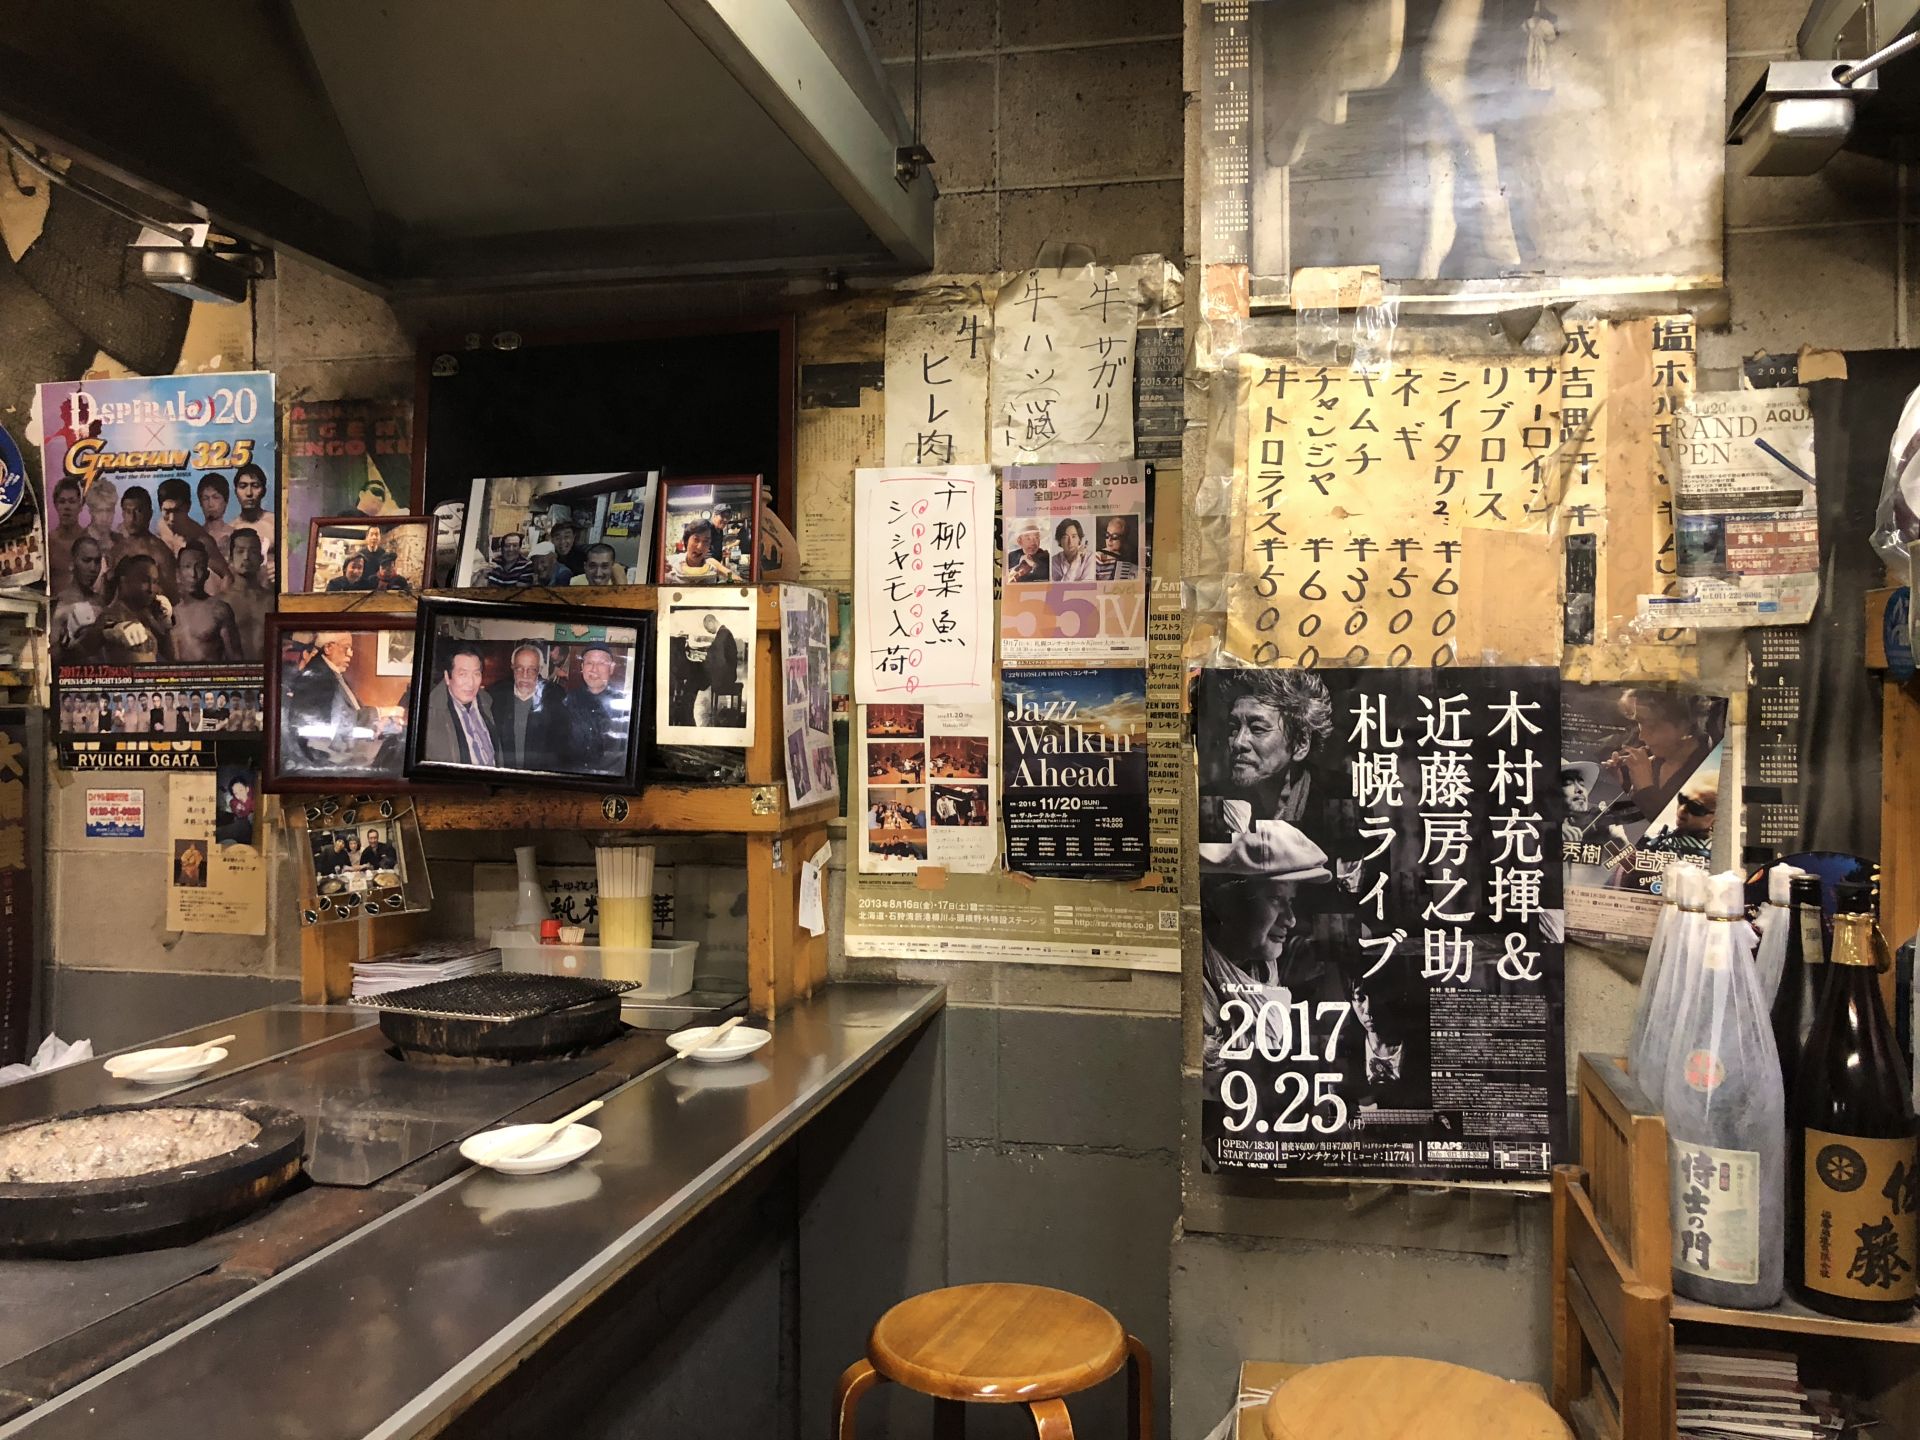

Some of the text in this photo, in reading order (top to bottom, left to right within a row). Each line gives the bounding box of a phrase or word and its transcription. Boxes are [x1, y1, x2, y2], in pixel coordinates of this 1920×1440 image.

[1080, 281, 1127, 441] 牛サガリ
[213, 388, 258, 424] 20
[1346, 368, 1381, 475] キムチ
[1392, 369, 1425, 461] ネギ
[1253, 365, 1300, 535] 牛トロライス
[1305, 367, 1341, 496] チャンジャ
[1473, 367, 1514, 521] リブロース
[65, 438, 255, 480] GRACHAN 32.5
[1034, 489, 1112, 501] 全国ツアー 2017
[1103, 475, 1138, 486] coba
[871, 501, 912, 675] シシャモ入荷
[1007, 693, 1078, 722] Jazz
[1007, 723, 1136, 755] Walkin'
[78, 754, 200, 767] RYUICHI OGATA
[1009, 757, 1118, 788] Ahead
[1039, 797, 1081, 810] 11/20
[1157, 807, 1178, 815] plenty
[1347, 692, 1408, 980] 札幌ライブ
[1417, 692, 1474, 984] 近藤房之助
[1485, 689, 1544, 983] 木村充揮&
[1563, 842, 1601, 865] 秀樹
[1605, 846, 1635, 868] TOUR2013
[1639, 874, 1663, 886] gues
[1218, 999, 1351, 1062] 2017
[1220, 1070, 1366, 1133] 9.25 (月)
[1222, 1139, 1275, 1150] OPEN/18:30
[1223, 1150, 1275, 1161] START/19:00
[1682, 1152, 1717, 1271] 侍士の門
